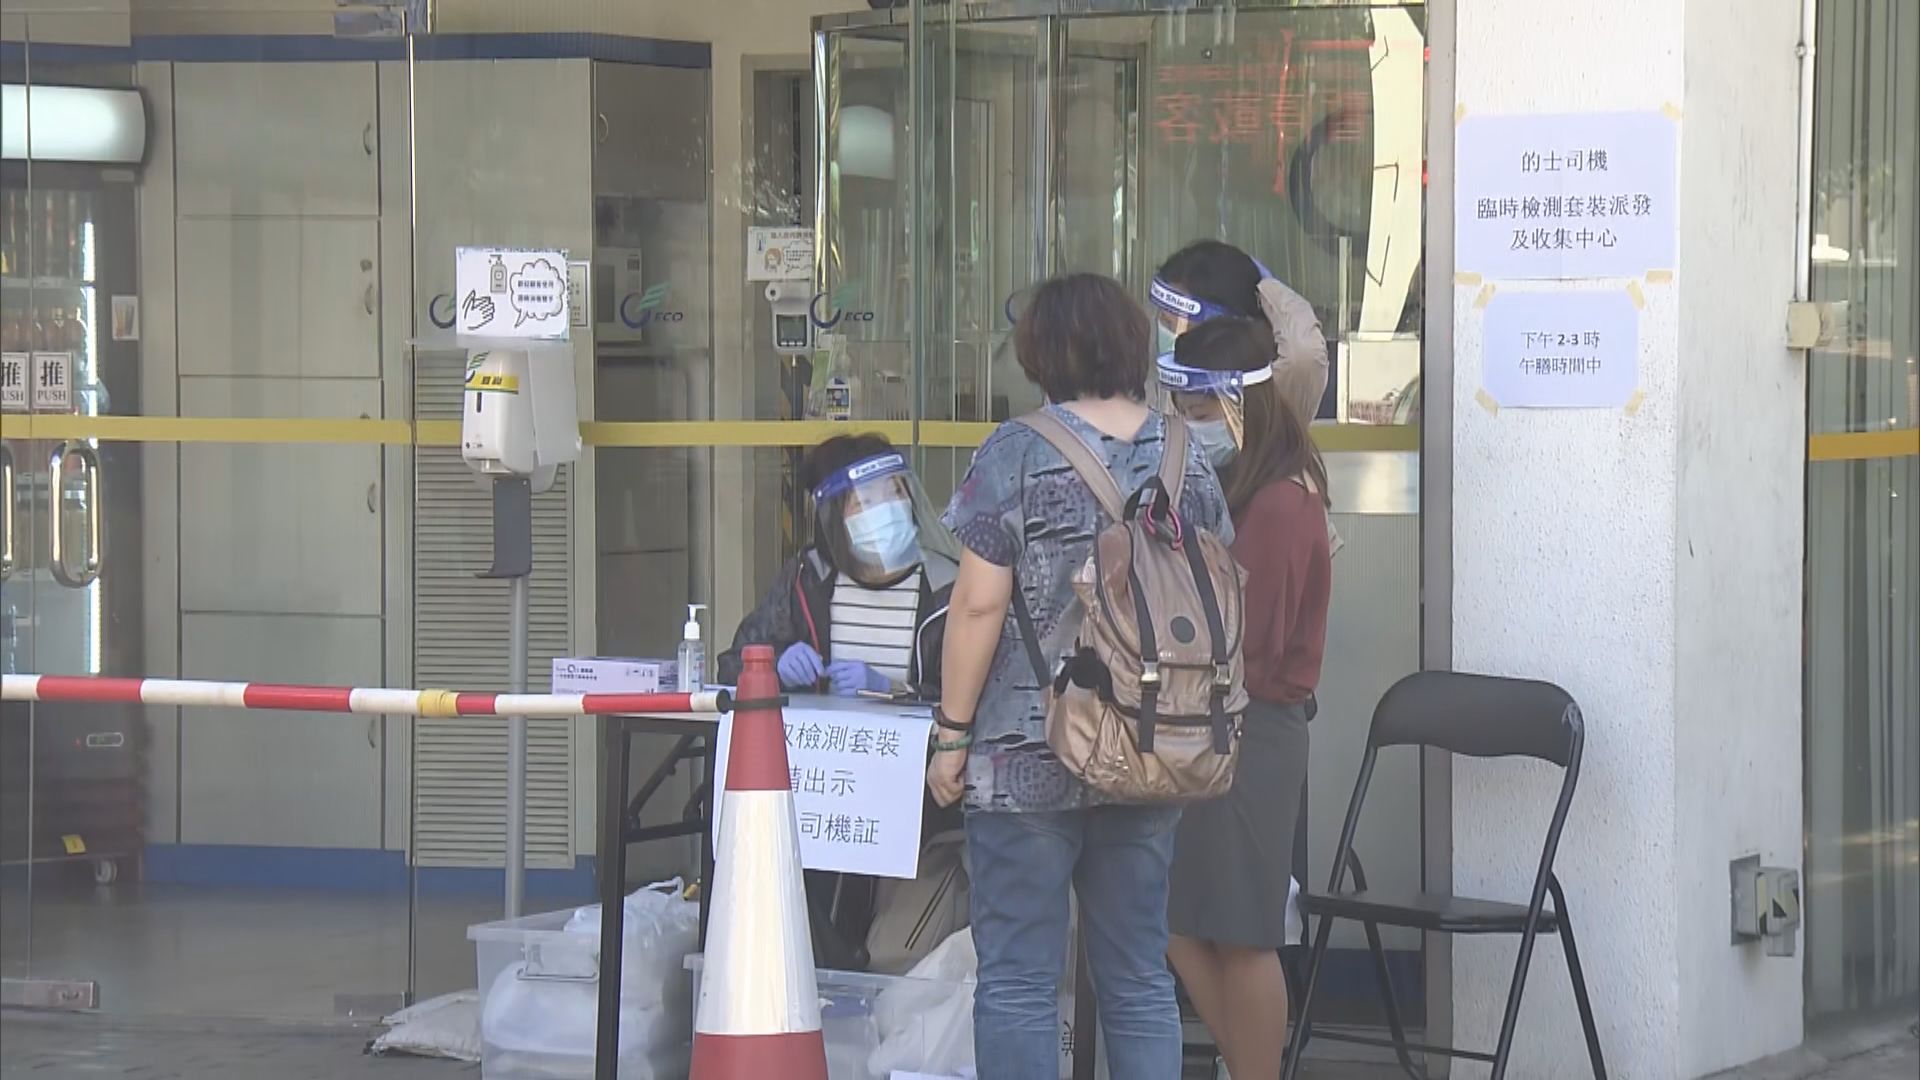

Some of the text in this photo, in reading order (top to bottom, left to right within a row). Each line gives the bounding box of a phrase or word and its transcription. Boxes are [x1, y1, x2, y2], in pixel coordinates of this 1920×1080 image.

[1521, 149, 1608, 173] 的士司機
[1477, 194, 1652, 219] 臨時檢測套裝派發
[1511, 227, 1617, 250] 及收集中心
[654, 312, 683, 321] ECO
[845, 312, 874, 321] ECO
[1520, 330, 1601, 349] 下午 2-3 時
[40, 360, 64, 387] 推
[1519, 357, 1601, 375] 午膳時間中
[1, 390, 24, 401] USH
[37, 390, 66, 401] PUSH
